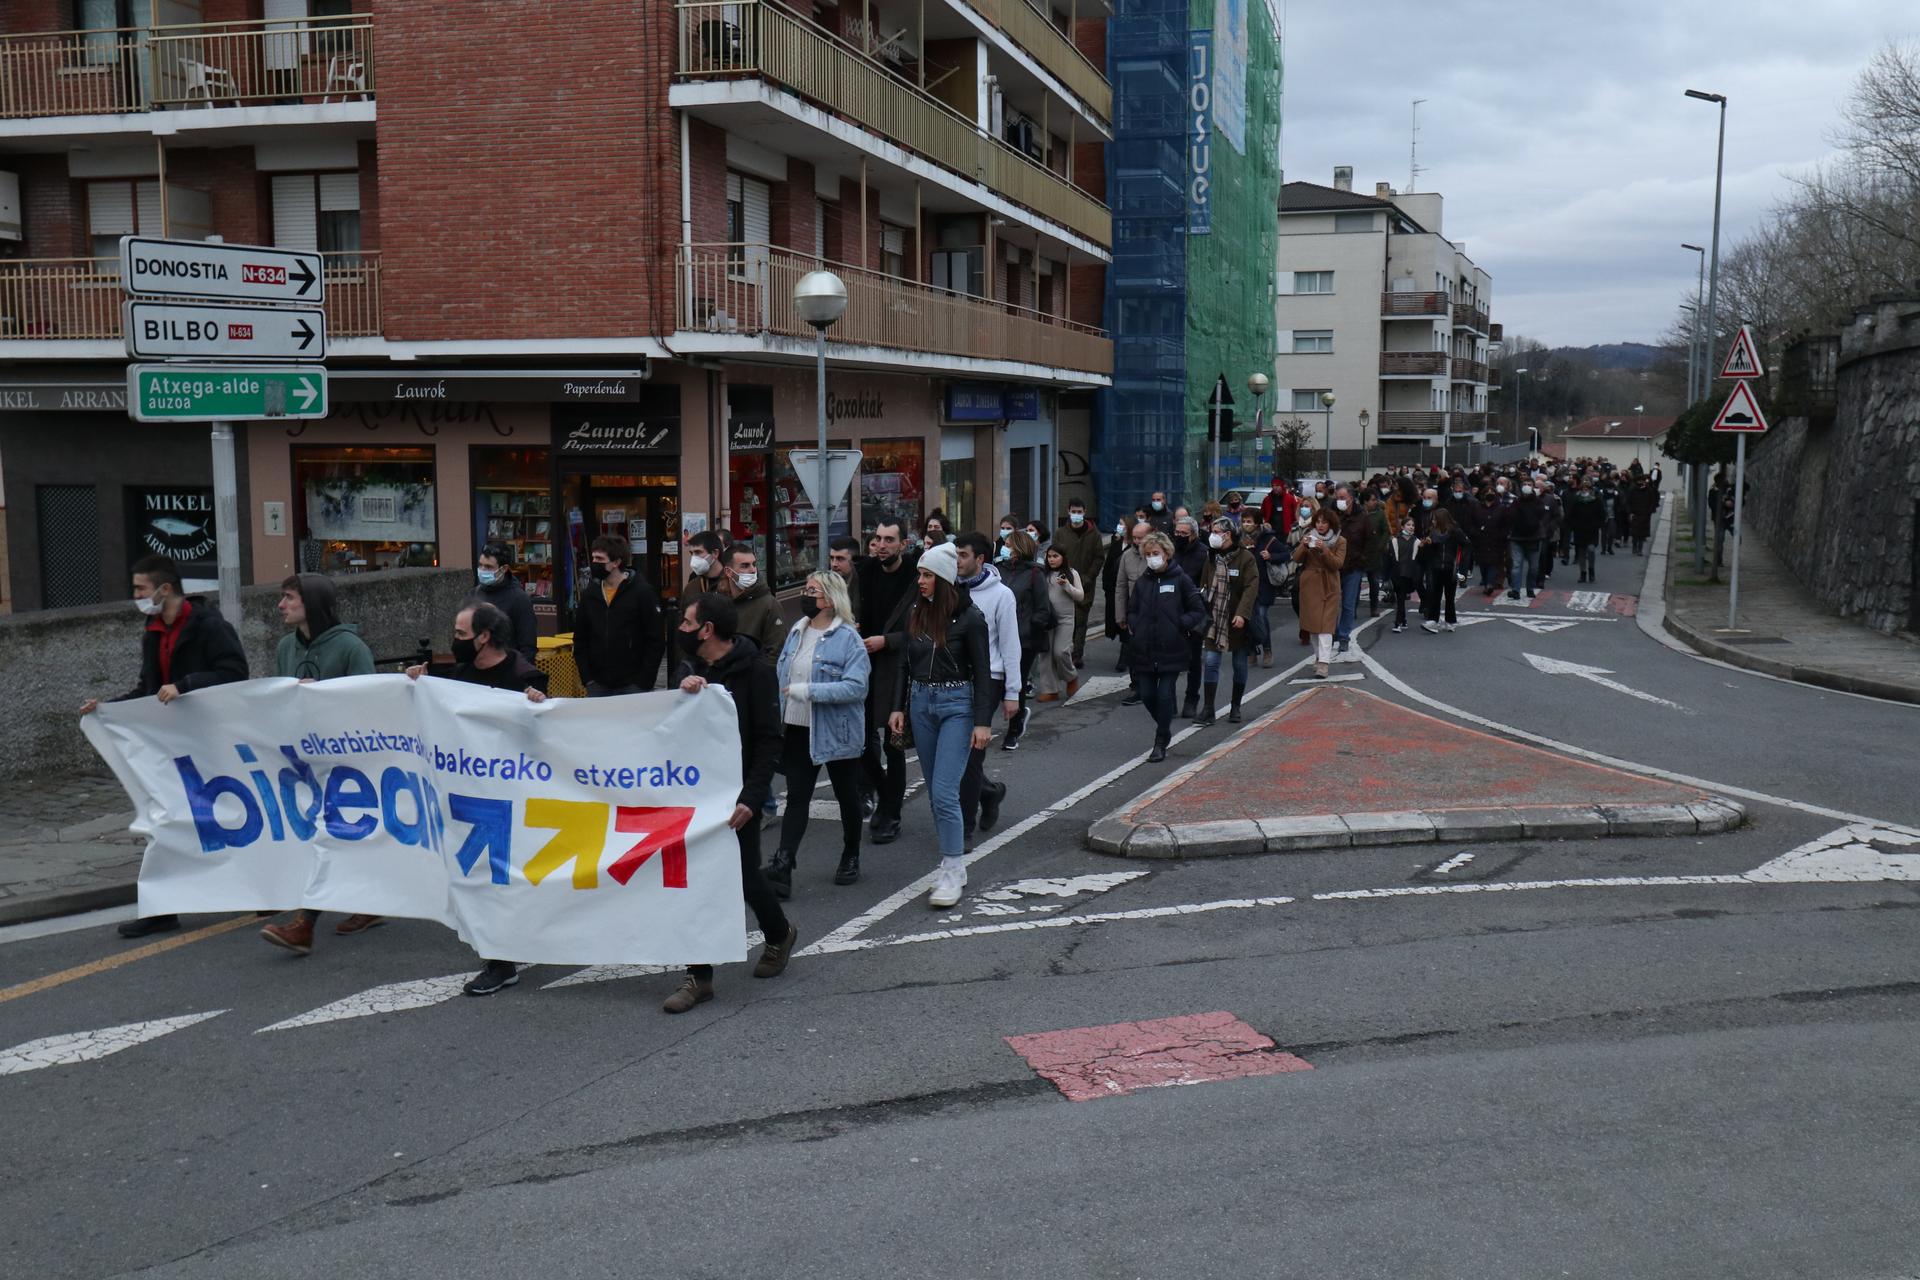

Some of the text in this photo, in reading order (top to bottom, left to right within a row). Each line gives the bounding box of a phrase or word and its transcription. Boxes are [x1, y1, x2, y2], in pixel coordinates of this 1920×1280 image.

[135, 258, 286, 284] DONOSTIA N-634
[144, 320, 252, 341] BILBO N-634
[149, 377, 260, 398] Atxega-alde
[394, 380, 447, 399] Laurok
[563, 380, 626, 398] Paperdenda
[60, 391, 128, 408] ARRAN
[148, 397, 191, 409] auzoa
[825, 389, 883, 425] Goxokiak
[568, 421, 647, 438] Laurok
[734, 422, 765, 439] Laurok
[145, 494, 212, 511] MIKEL
[143, 533, 216, 561] ARRANDEGIA
[434, 745, 553, 782] bakerako
[574, 760, 701, 789] etxerako
[172, 743, 444, 853] bidean
